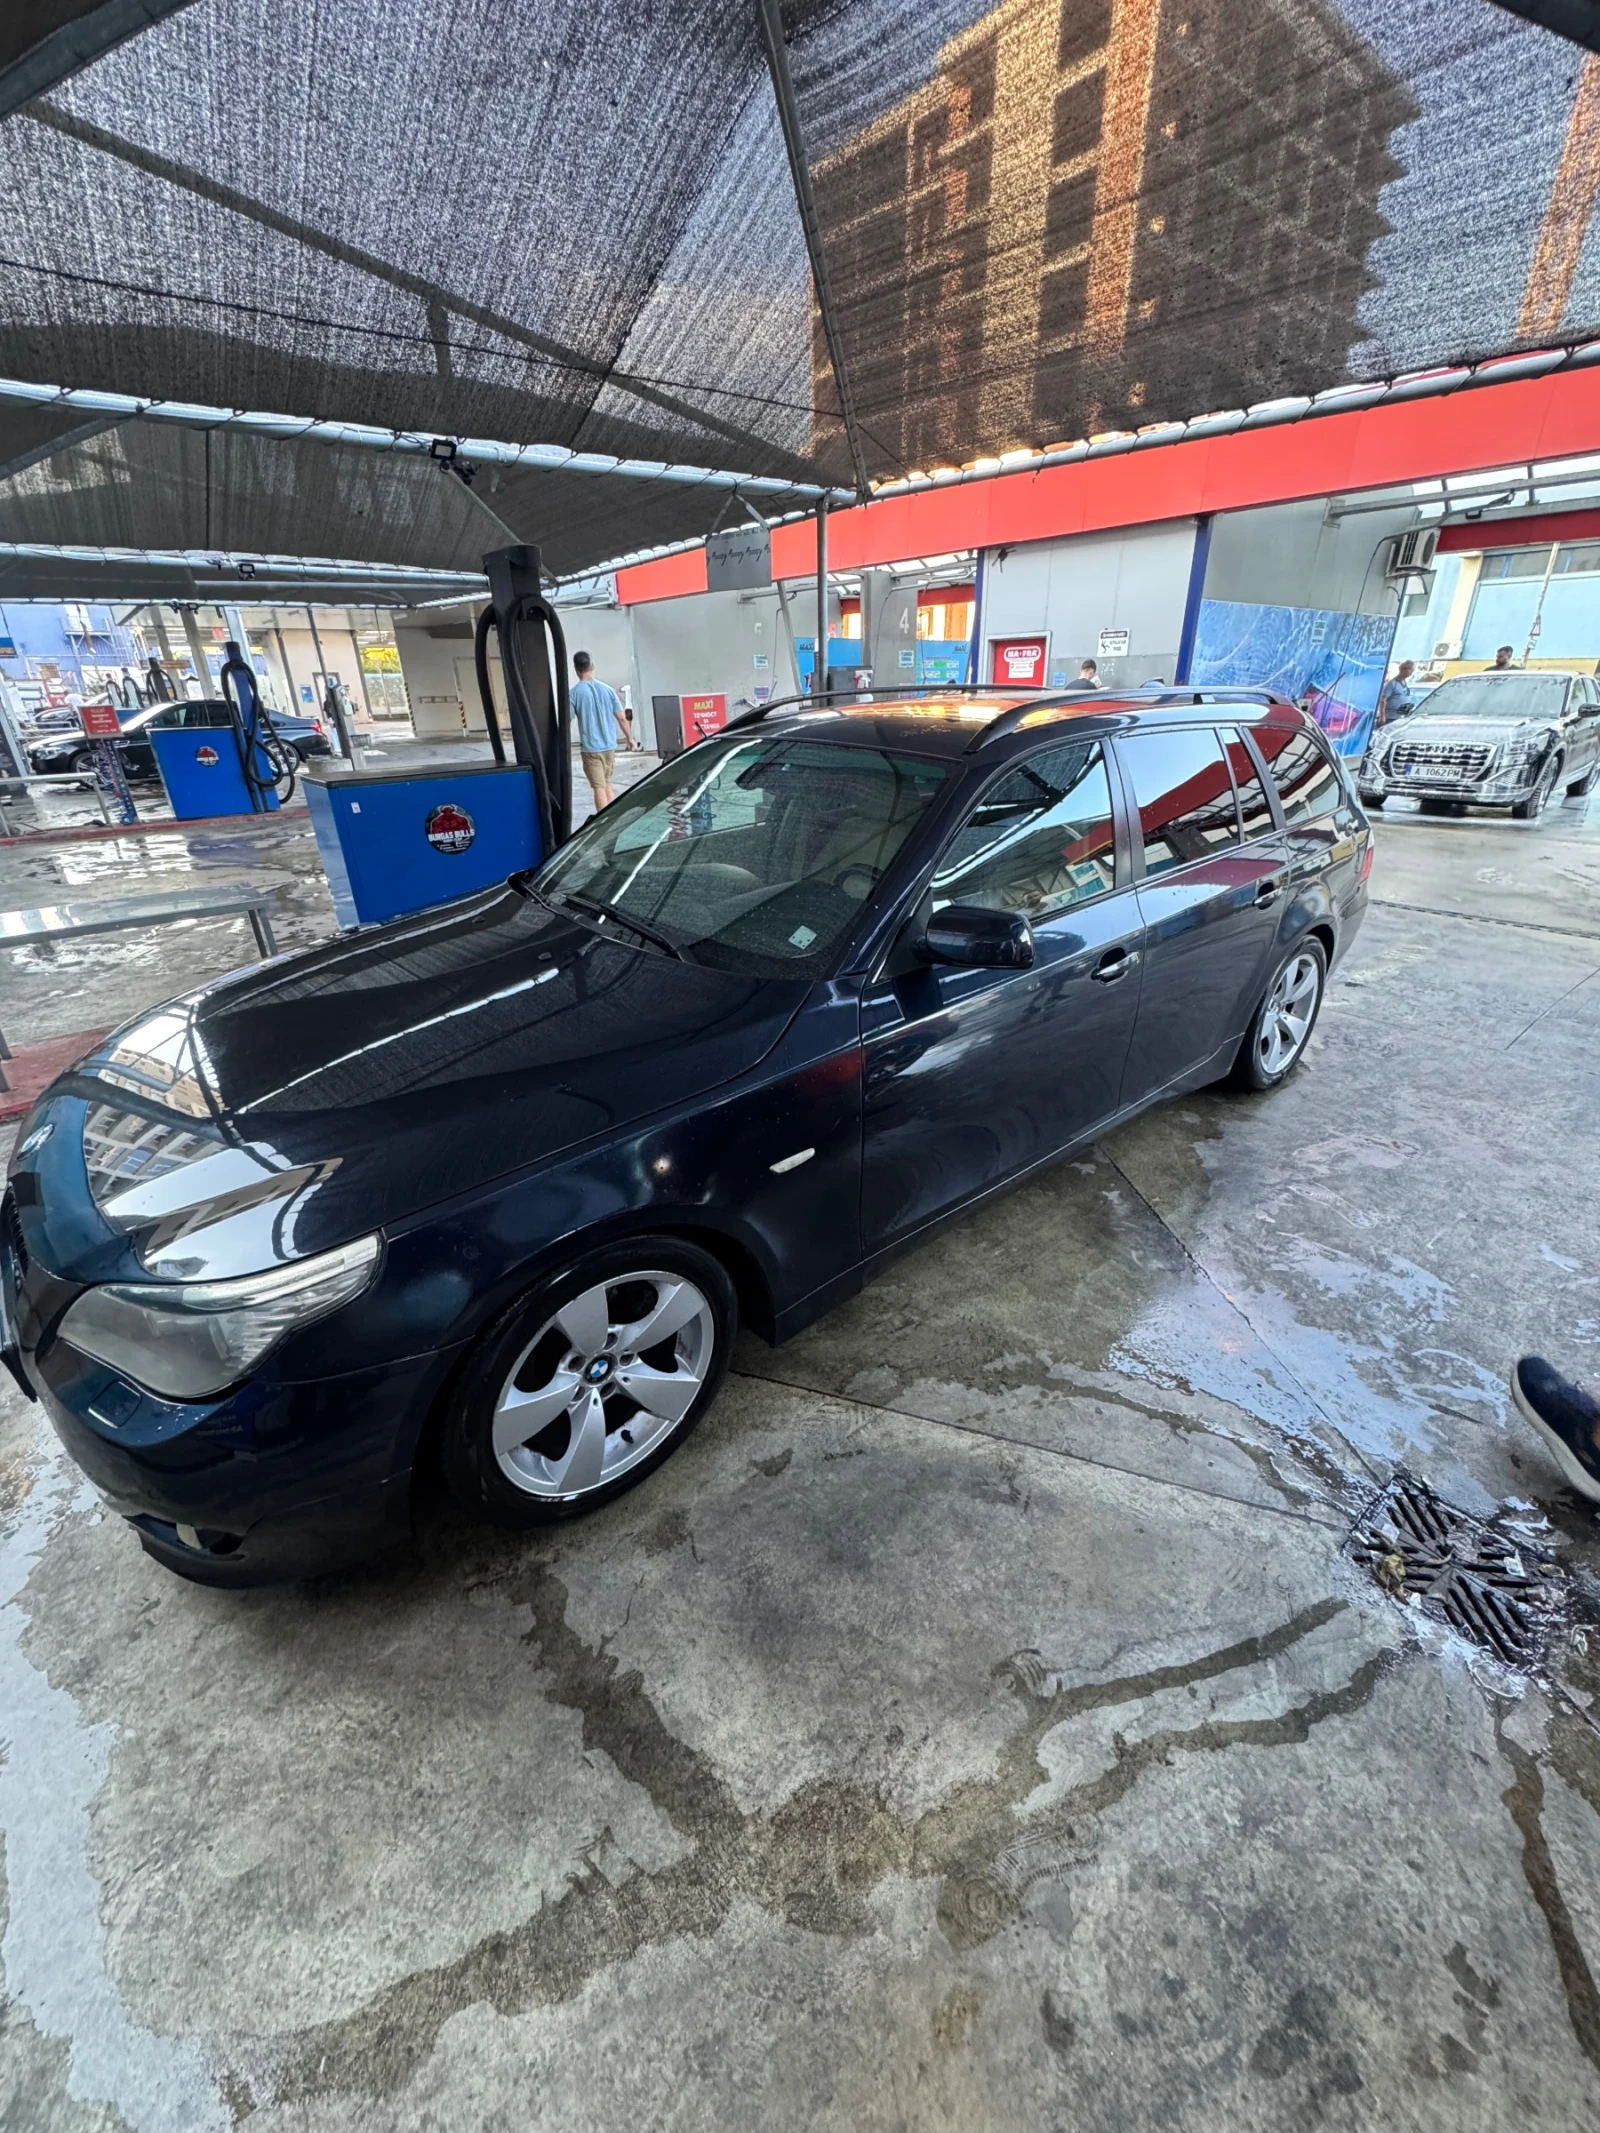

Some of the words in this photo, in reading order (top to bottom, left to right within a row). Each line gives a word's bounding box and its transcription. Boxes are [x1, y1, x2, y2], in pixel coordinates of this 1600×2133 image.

[899, 607, 910, 634] 4
[693, 697, 714, 710] MAXI
[693, 711, 717, 719] ТЕЧНОСТ
[692, 723, 720, 731] ЧСТАЧКИ
[1414, 768, 1420, 776] A
[428, 831, 454, 842] BURGAS
[454, 829, 475, 838] BULLS
